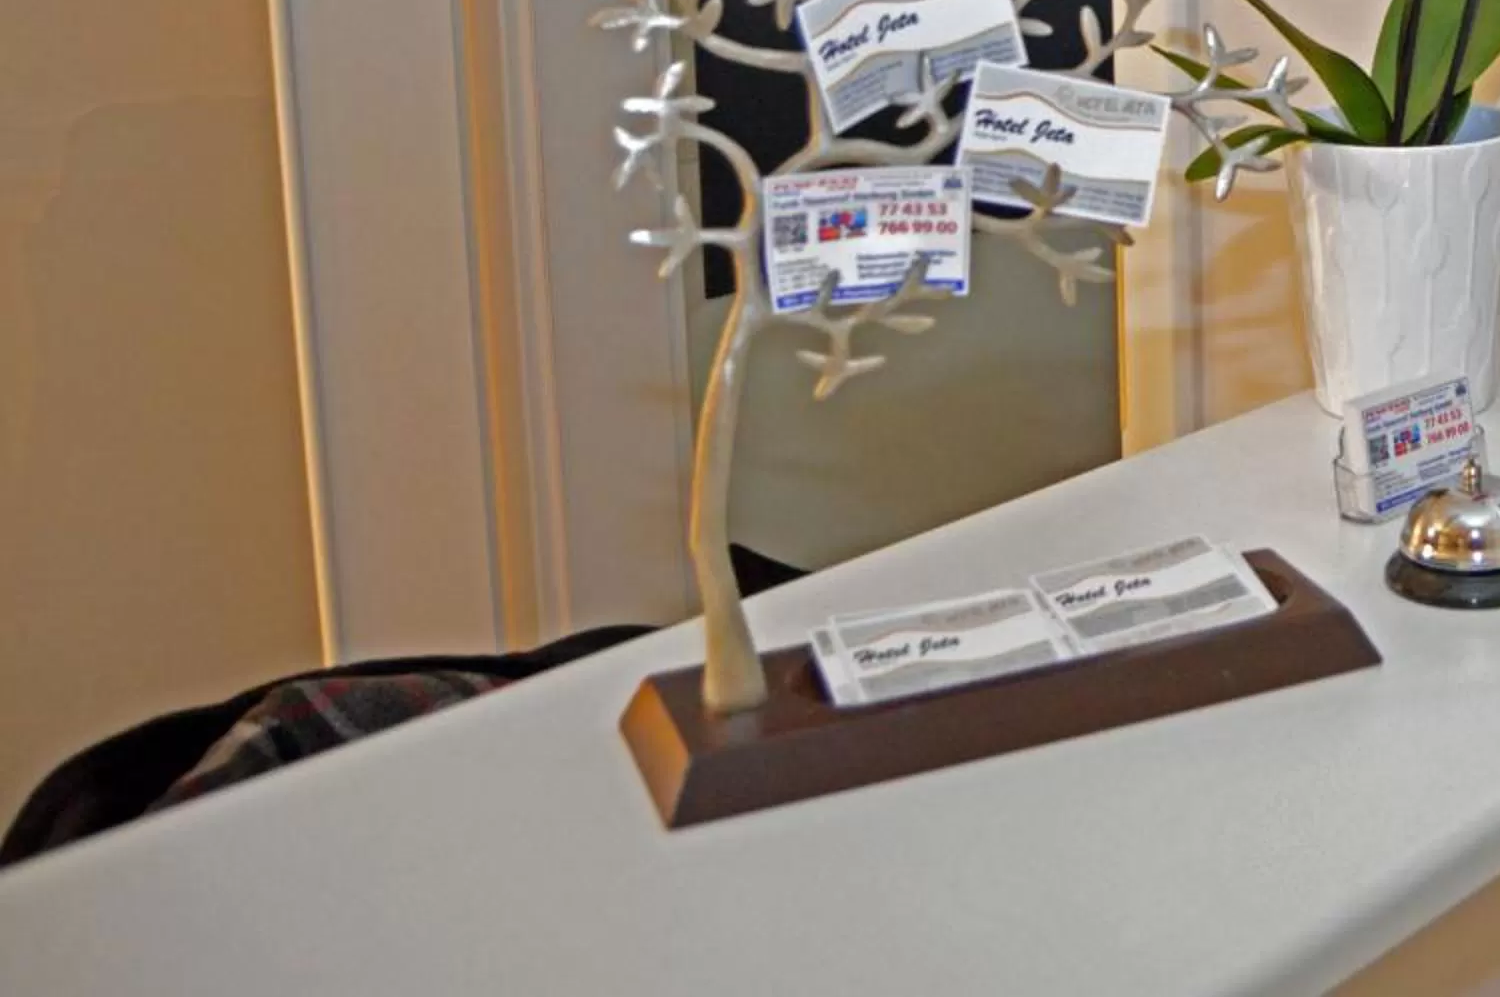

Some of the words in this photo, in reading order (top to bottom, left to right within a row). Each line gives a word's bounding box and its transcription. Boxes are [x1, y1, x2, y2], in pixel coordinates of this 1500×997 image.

[819, 24, 870, 60] Hotel
[877, 12, 920, 43] Jeta
[974, 108, 1030, 135] Hotel
[1029, 120, 1075, 145] Jeta
[878, 203, 898, 216] 77
[902, 203, 922, 216] 43
[927, 202, 947, 215] 53
[877, 220, 909, 235] 766
[912, 220, 932, 235] 99
[936, 220, 958, 235] 00
[1055, 586, 1107, 607] Hotel
[1114, 577, 1152, 596] Jeta
[853, 643, 910, 664] Hotel
[918, 636, 960, 656] Jeta
